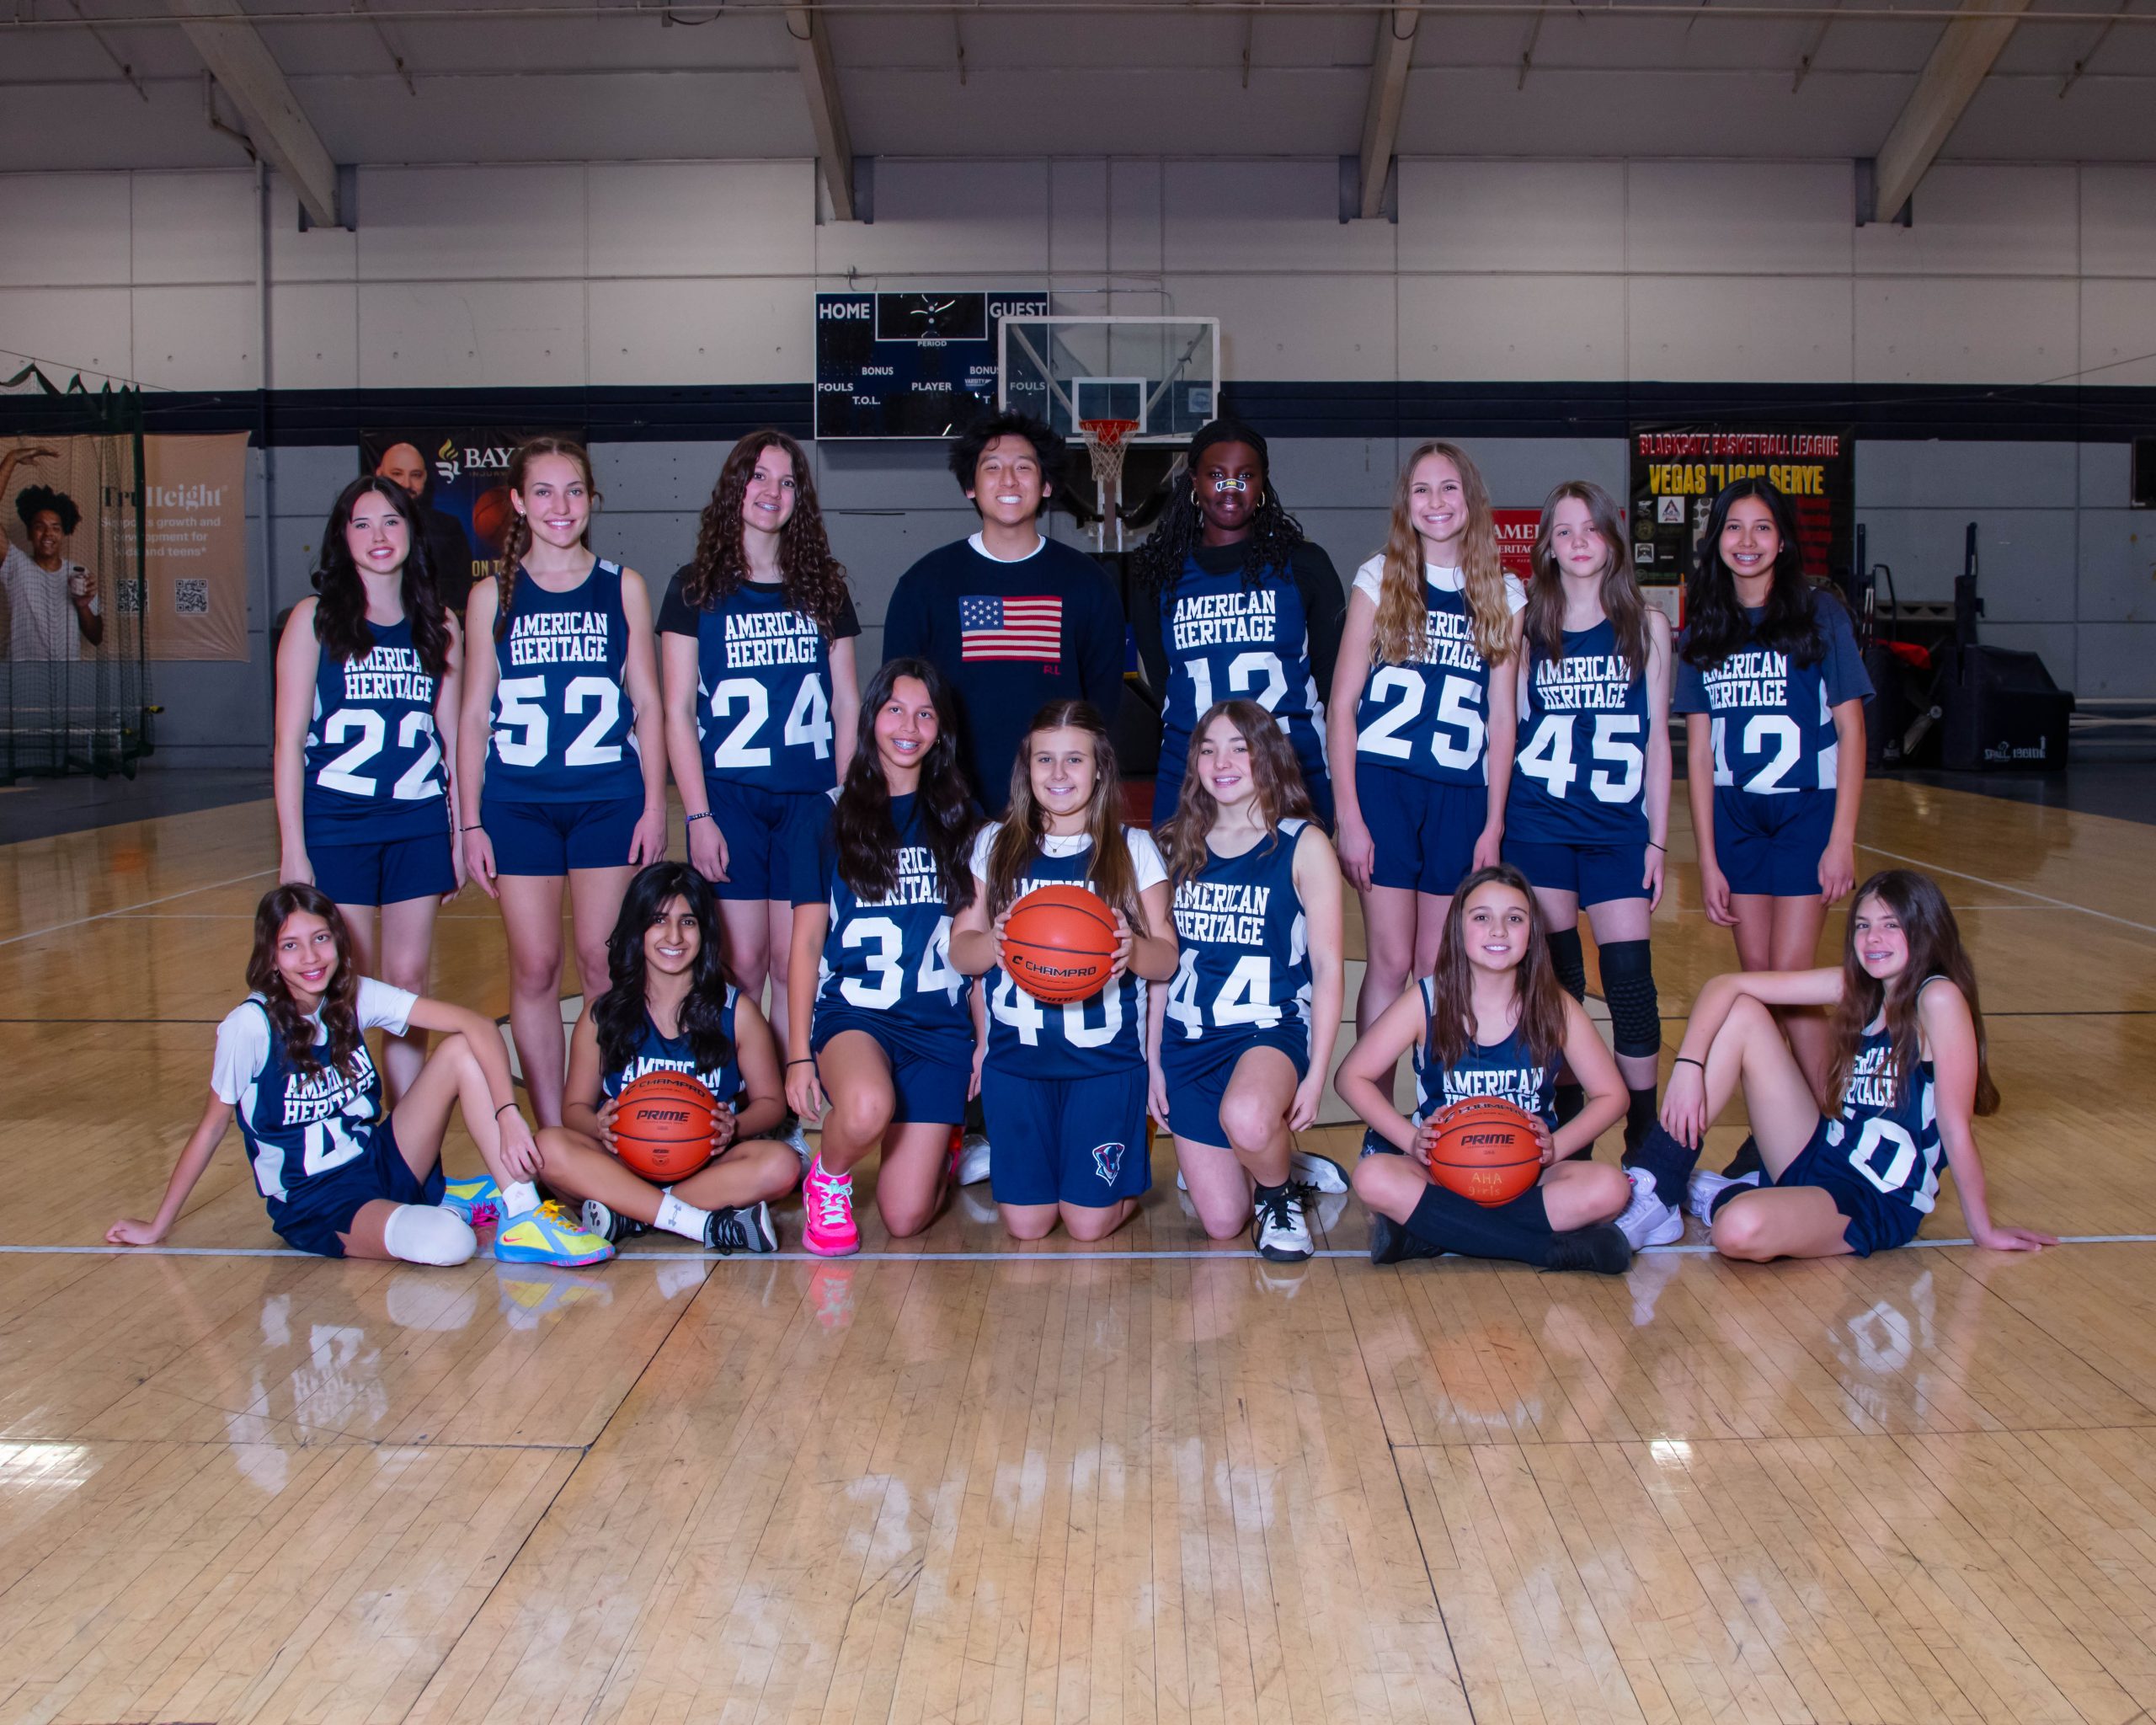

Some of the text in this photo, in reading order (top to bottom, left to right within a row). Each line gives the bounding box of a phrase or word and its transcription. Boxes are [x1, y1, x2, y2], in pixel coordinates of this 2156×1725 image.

[819, 303, 870, 319] HOME
[990, 302, 1047, 318] GUEST
[862, 366, 894, 376] BONUS
[818, 382, 853, 392] FOULS
[852, 396, 881, 404] T.O.L.
[911, 382, 952, 391] PLAYER
[1010, 382, 1045, 391] FOULS
[1712, 434, 1790, 456] BASKETBALL
[1792, 435, 1839, 456] LEAGUE
[1649, 463, 1706, 494] VEGAS
[1769, 465, 1825, 494] SERYE
[157, 517, 198, 529] growth
[200, 516, 221, 527] and
[192, 531, 208, 542] for
[472, 560, 489, 577] ON
[1173, 590, 1276, 623] AMERICAN
[510, 611, 607, 640] AMERICAN
[724, 611, 819, 641] AMERICAN
[1173, 616, 1276, 650] HERITAGE
[344, 646, 423, 673] AMERICA
[510, 636, 607, 665] HERITAGE
[725, 637, 819, 668] HERITAGE
[345, 673, 434, 702] HERITAGE
[1184, 652, 1291, 734] 12
[1537, 683, 1629, 710] HERITAGE
[1705, 680, 1787, 710] HERITAGE
[494, 675, 622, 767] 52
[711, 672, 832, 768] 24
[1357, 665, 1485, 770] 25
[317, 708, 444, 800] 22
[1518, 714, 1643, 804] 45
[1710, 714, 1801, 795] 12
[1174, 880, 1270, 916] AMERICAN
[1173, 911, 1265, 946] HERITAGE
[840, 916, 964, 1010] 34
[1025, 960, 1097, 978] CHAMPRO
[1166, 948, 1283, 1039] 44
[991, 969, 1122, 1048] 40
[639, 1078, 706, 1098] CHAMPRO
[1443, 1066, 1544, 1095] AMERICAN
[637, 1110, 690, 1122] PRIME
[1461, 1134, 1515, 1146] PRIME
[1472, 1172, 1502, 1184] AHA
